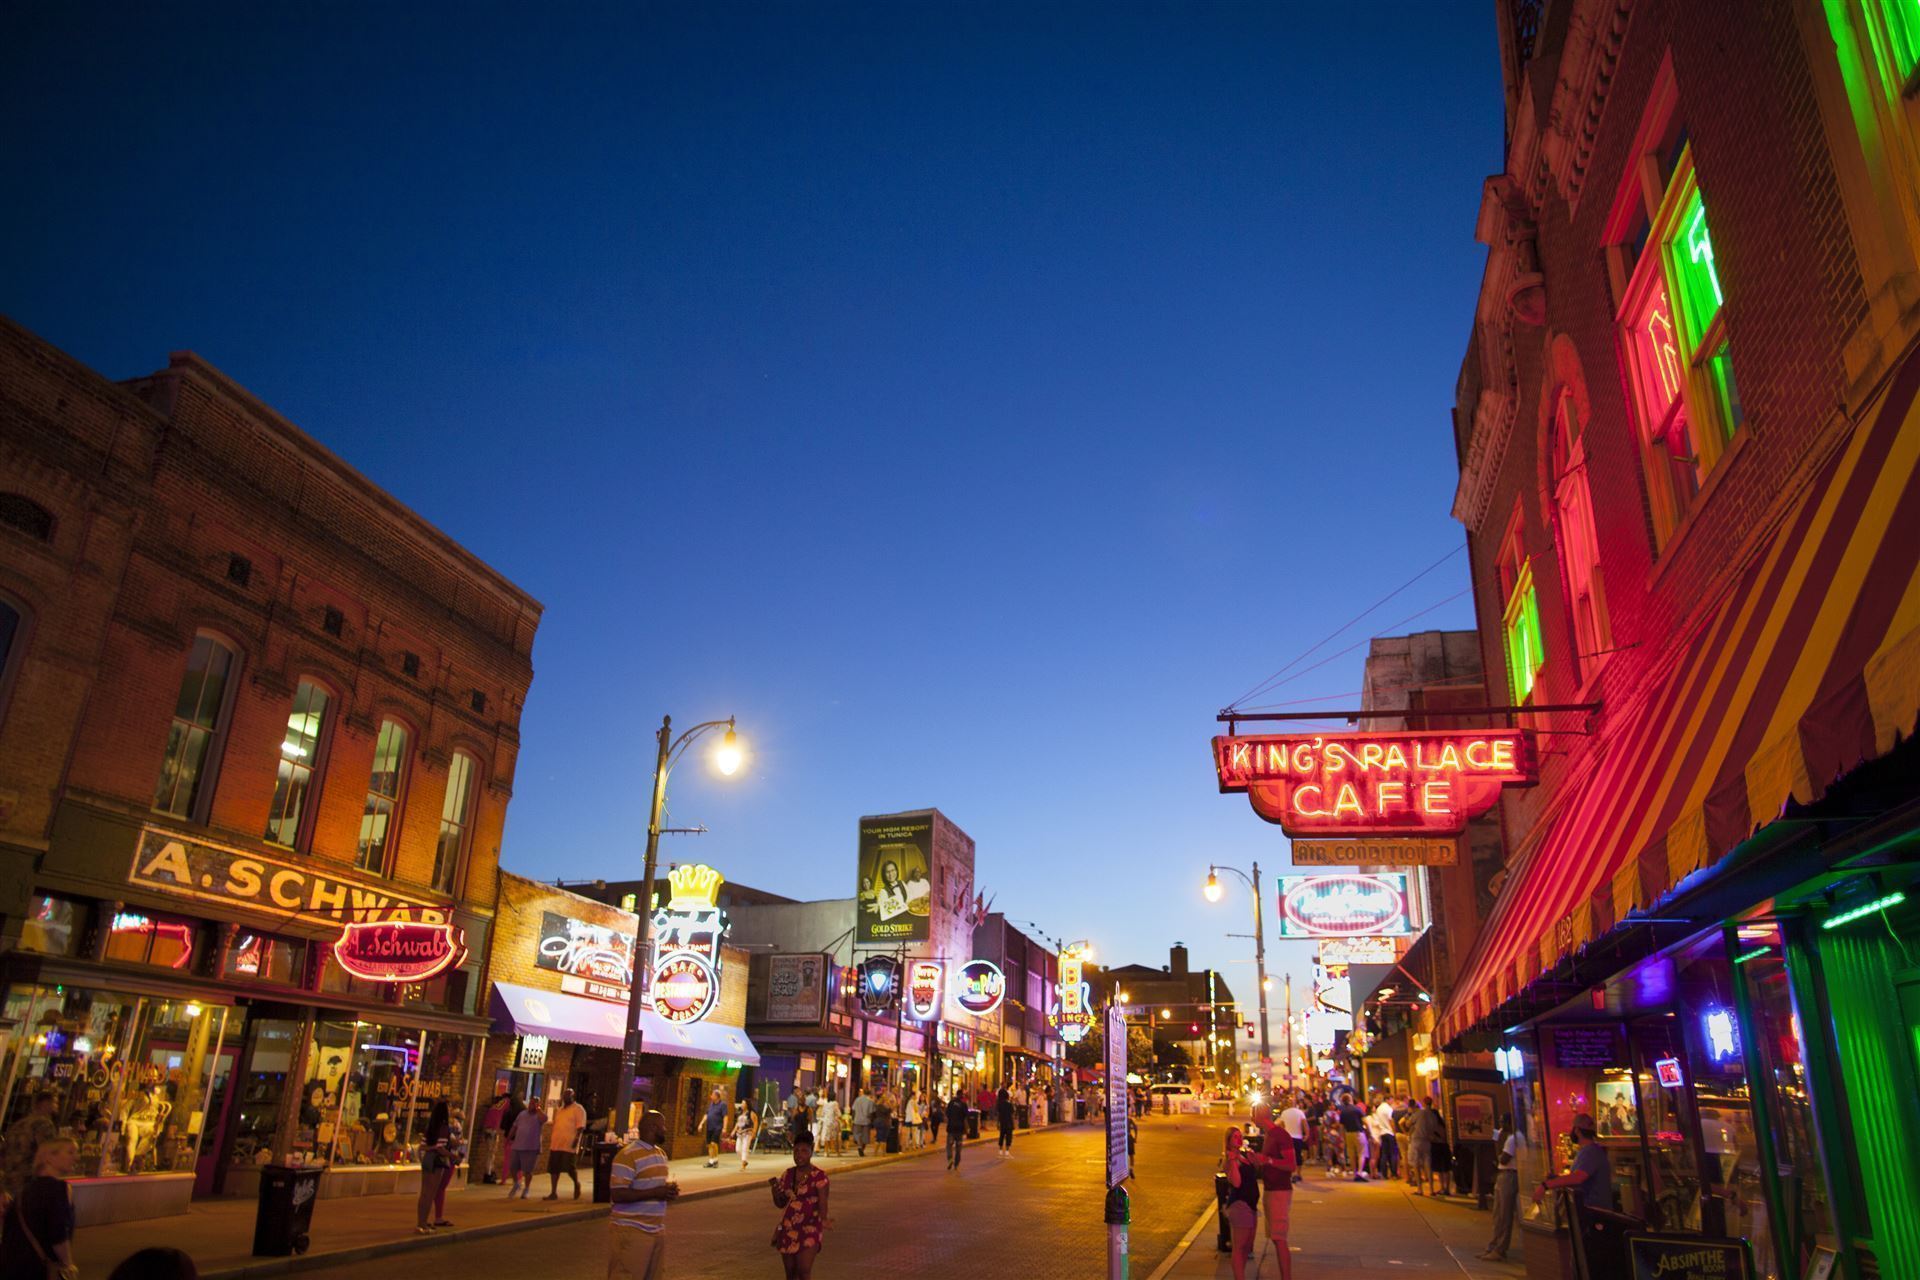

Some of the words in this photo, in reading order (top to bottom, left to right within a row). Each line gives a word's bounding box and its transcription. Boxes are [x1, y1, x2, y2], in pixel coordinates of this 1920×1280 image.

[1232, 737, 1345, 773] KING'S
[1291, 782, 1453, 818] CAFE
[863, 825, 882, 835] YOUR
[883, 825, 901, 833] MGM
[901, 824, 929, 832] RESORT
[1298, 845, 1325, 862] AIR
[871, 923, 890, 934] GOLD
[889, 923, 913, 933] STRIKE
[1557, 915, 1573, 950] 162
[367, 928, 447, 957] Schwab
[670, 960, 697, 975] BAR
[523, 1047, 544, 1066] BEER
[1651, 1249, 1726, 1278] ABSINTHE
[1702, 1263, 1726, 1273] ROOM
